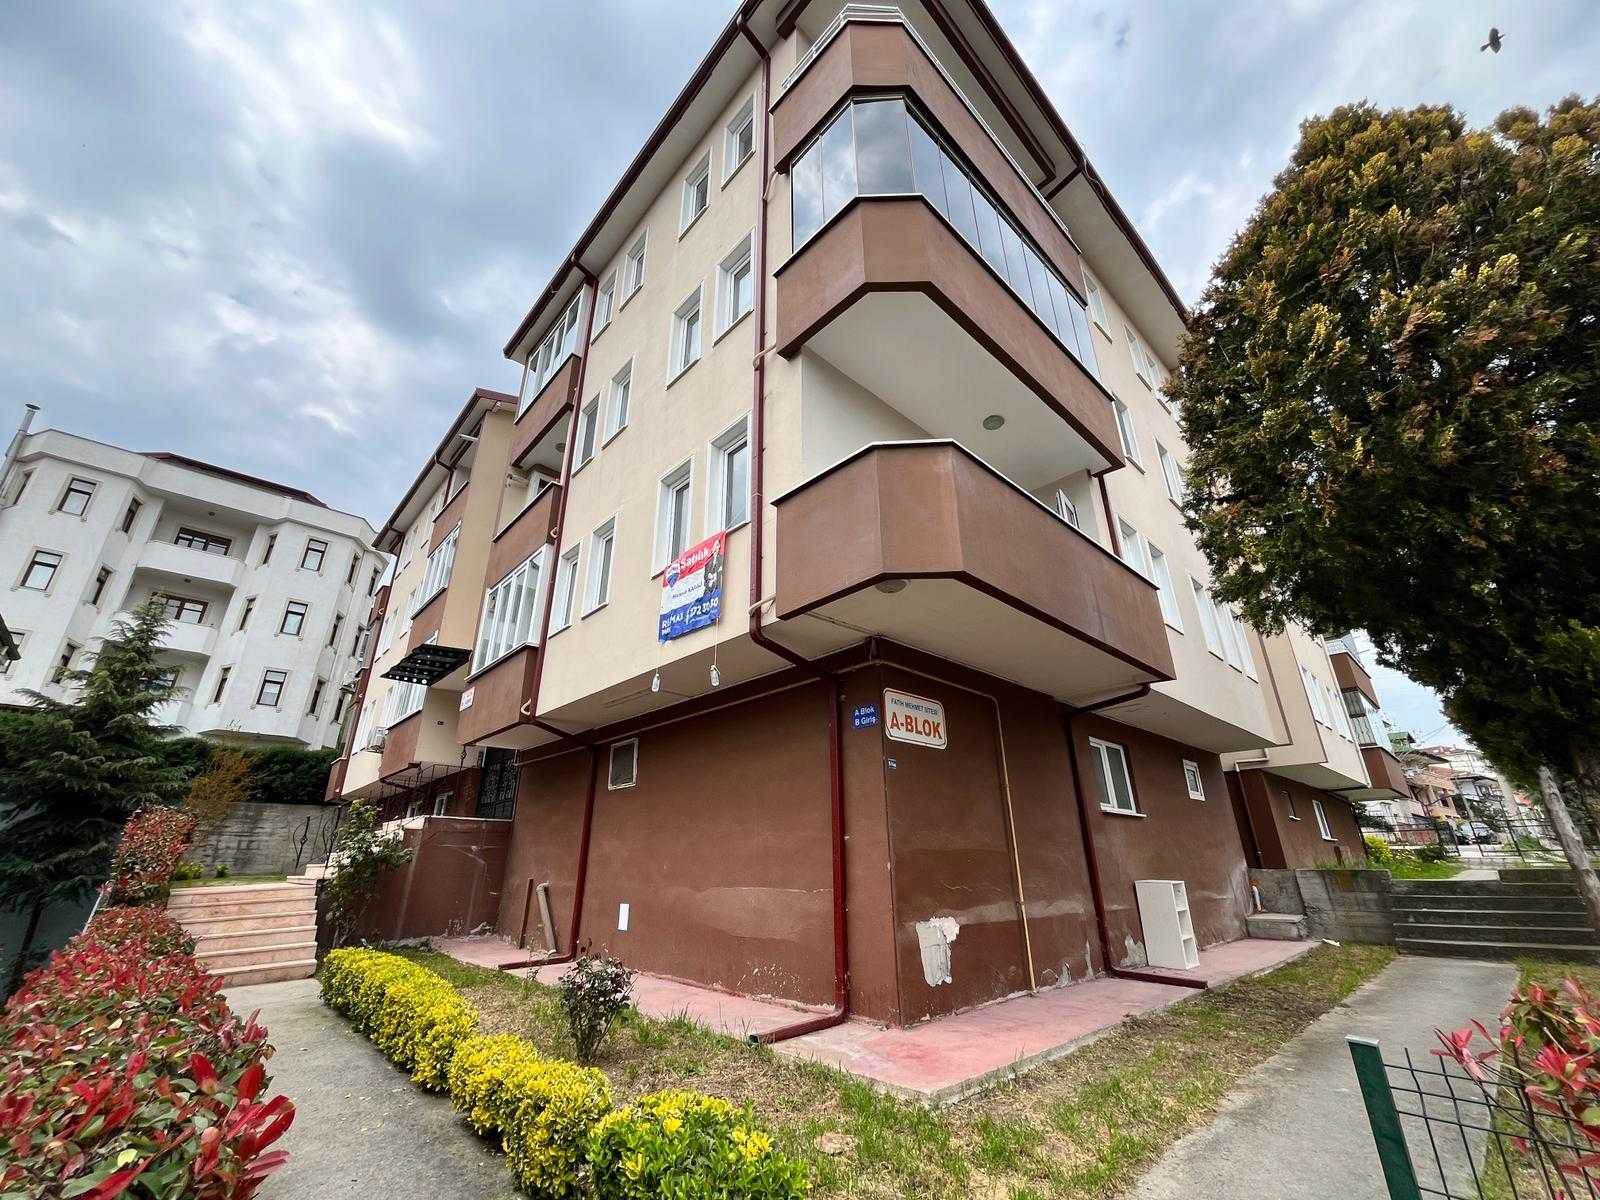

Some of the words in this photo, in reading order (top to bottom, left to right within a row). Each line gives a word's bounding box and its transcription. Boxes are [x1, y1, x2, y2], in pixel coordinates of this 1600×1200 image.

[860, 706, 875, 715] Blok
[854, 718, 860, 726] B
[890, 711, 943, 740] A-BLOK
